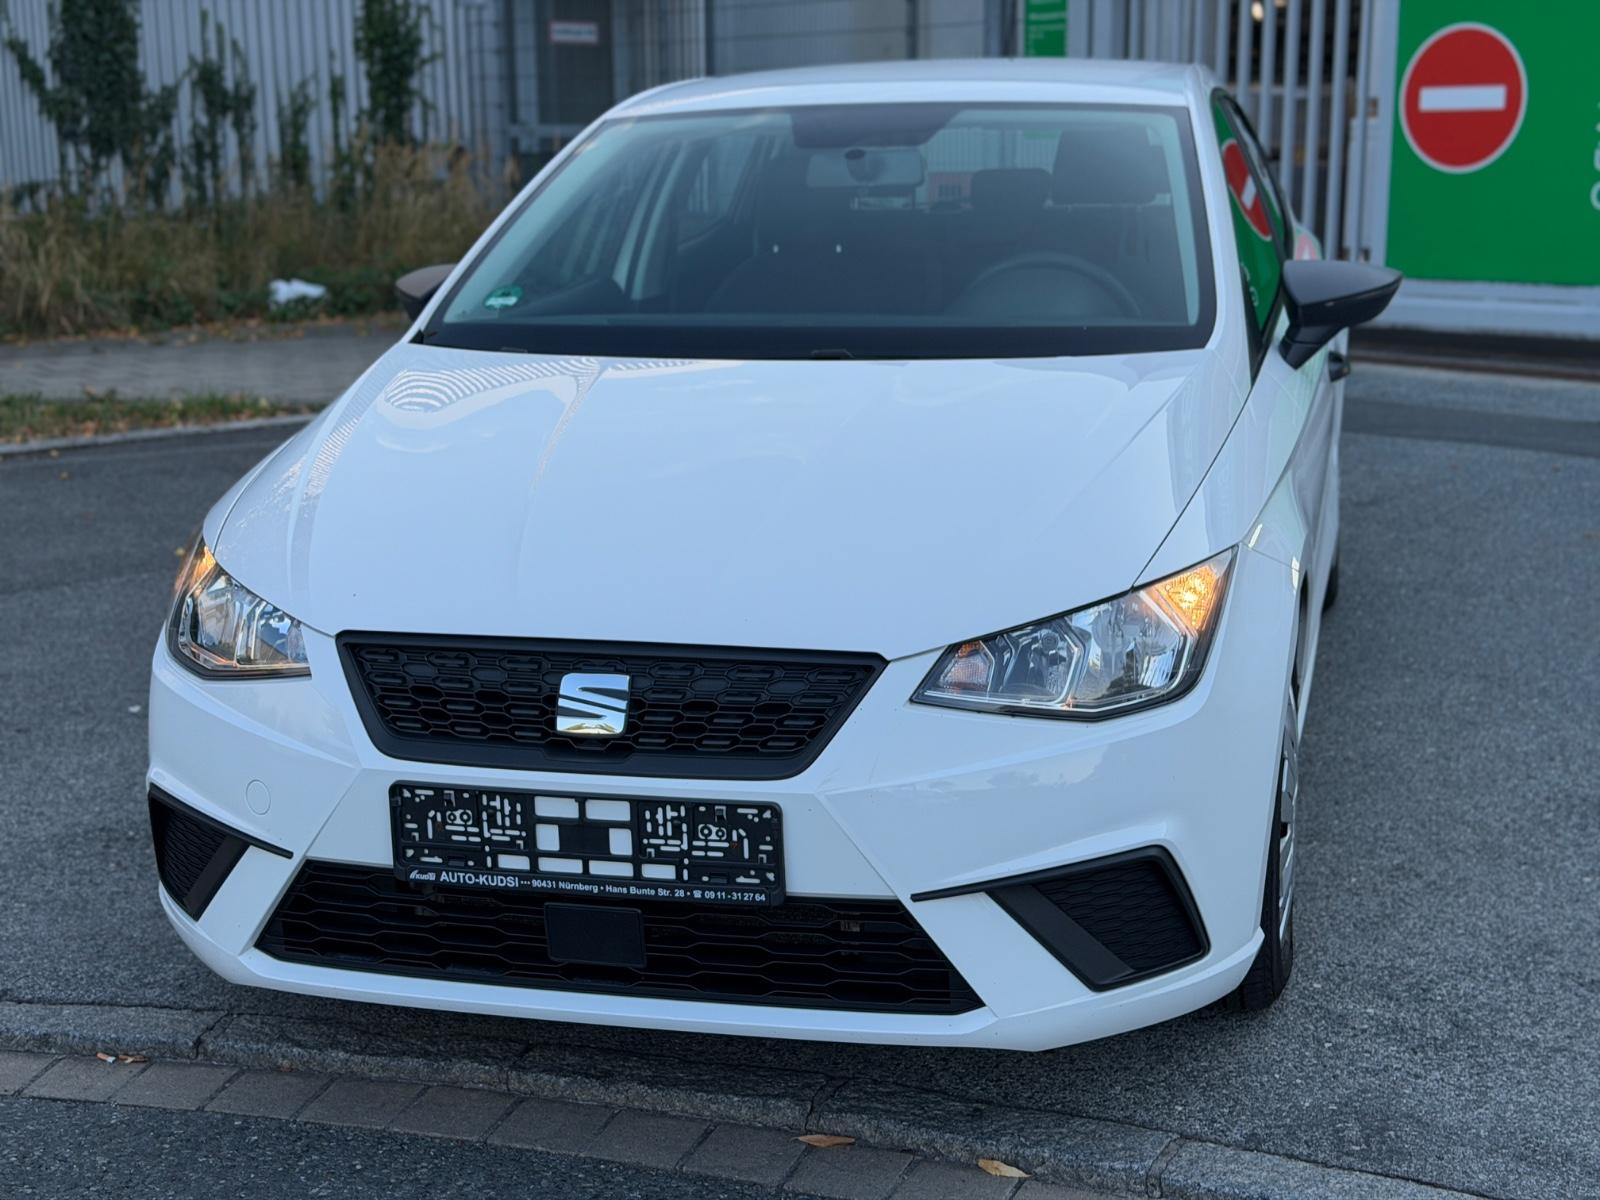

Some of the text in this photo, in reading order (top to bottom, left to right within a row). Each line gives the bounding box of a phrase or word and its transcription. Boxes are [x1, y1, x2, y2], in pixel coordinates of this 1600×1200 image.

[440, 870, 519, 888] AUTO-KUDSI
[532, 879, 557, 889] 90431
[558, 880, 599, 894] Nürnberg
[605, 884, 628, 894] Hans
[657, 887, 673, 897] Str.
[674, 888, 685, 898] 28
